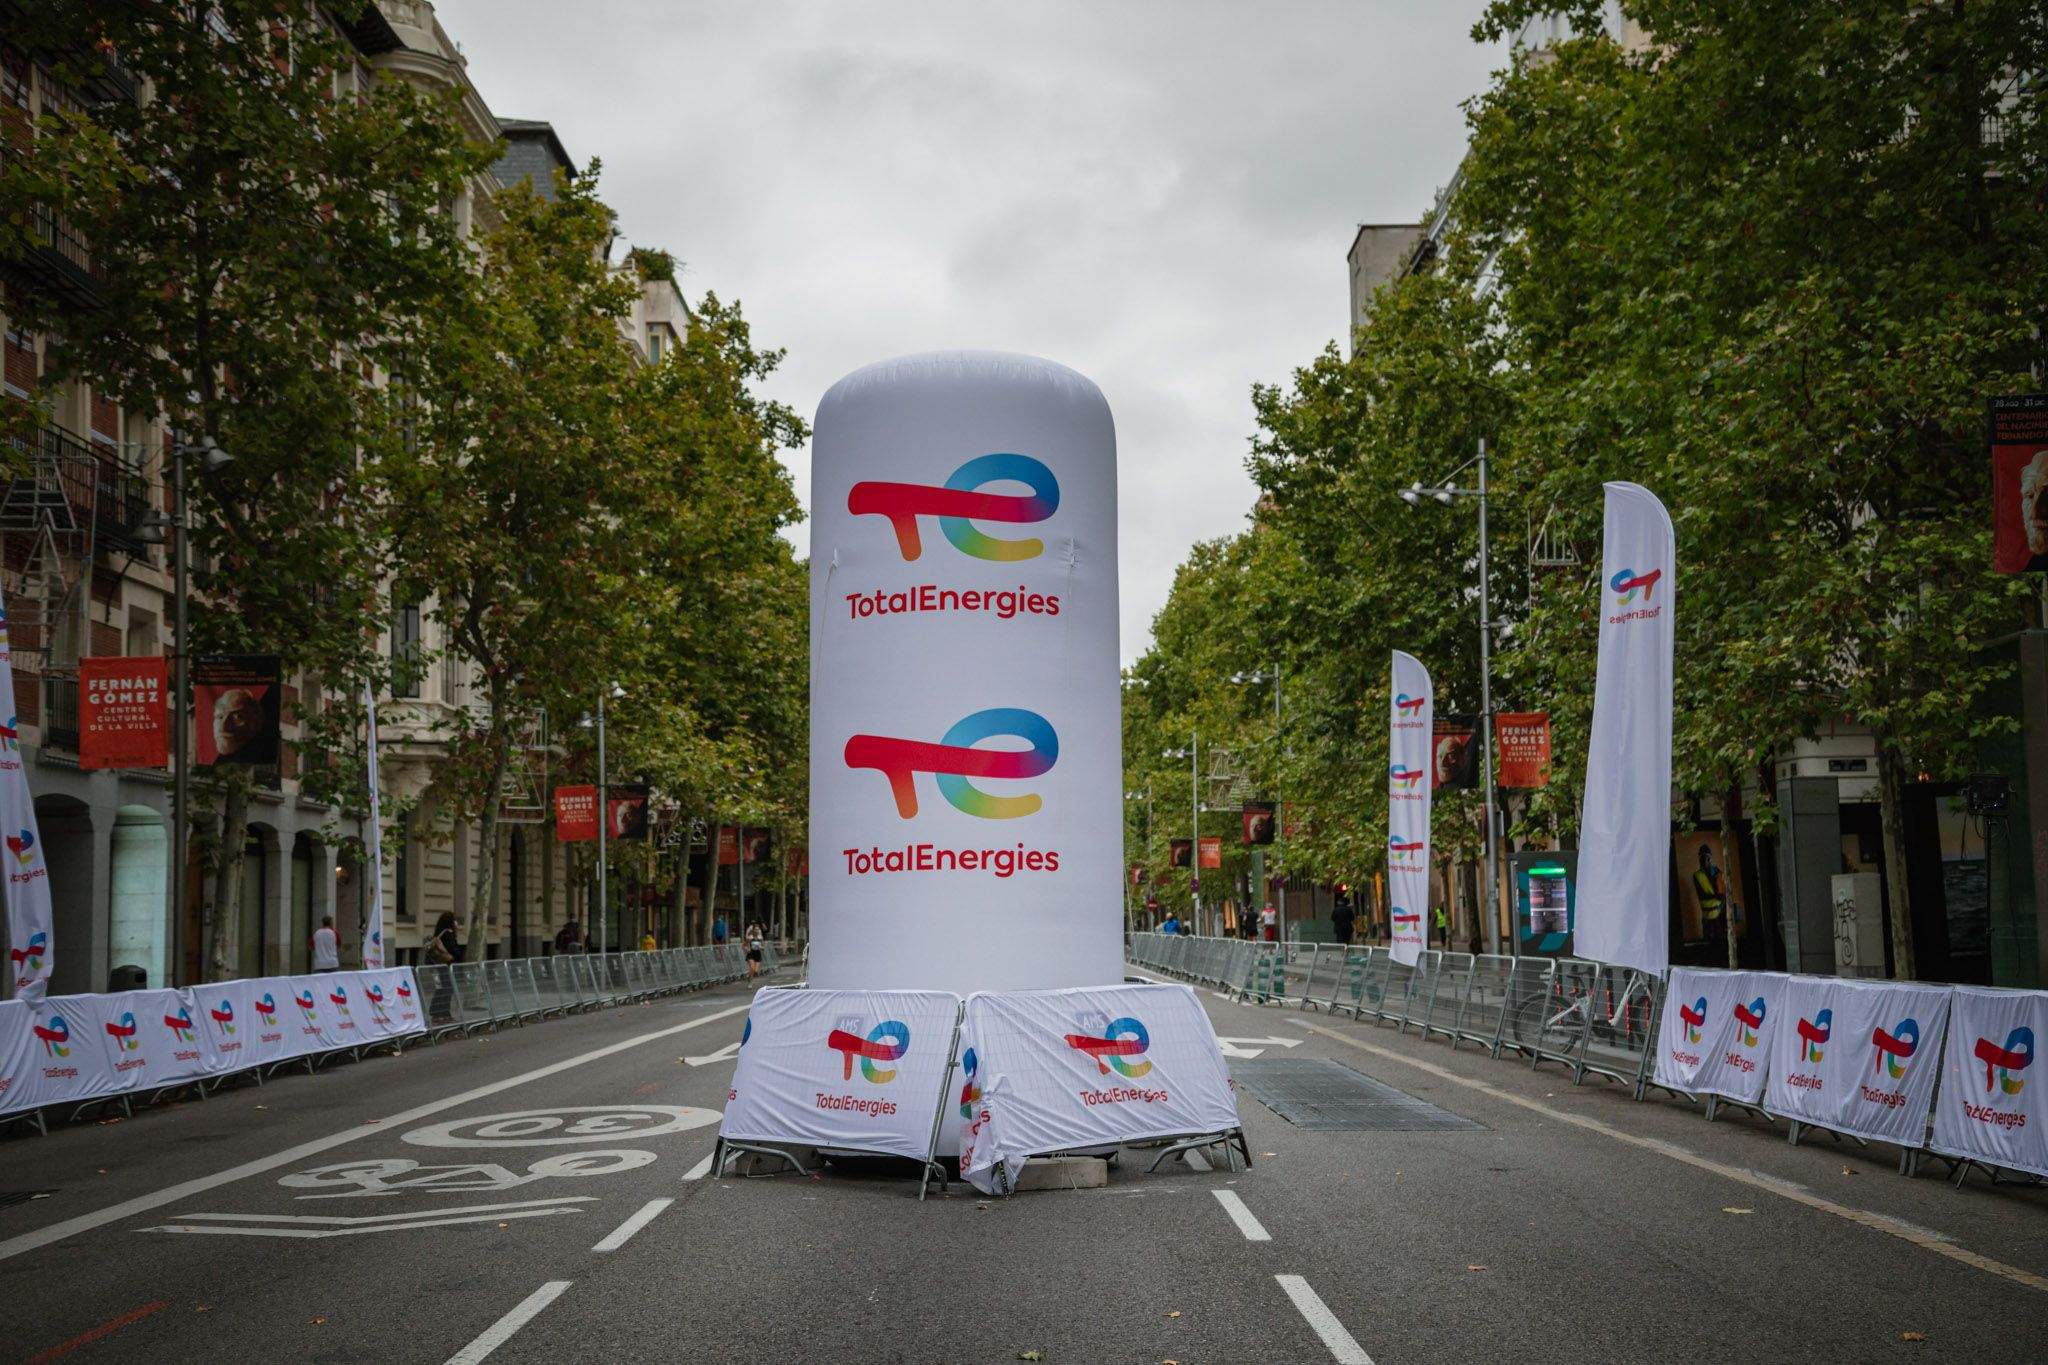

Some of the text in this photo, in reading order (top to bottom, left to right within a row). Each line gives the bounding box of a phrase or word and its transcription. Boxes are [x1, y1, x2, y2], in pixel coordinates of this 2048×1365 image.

[846, 585, 1060, 619] TotalEnergies
[89, 676, 158, 690] FERNÁN
[89, 690, 158, 704] GÓMEZ
[843, 843, 1060, 878] TotalEnergies
[815, 1093, 897, 1117] TotalEnergies
